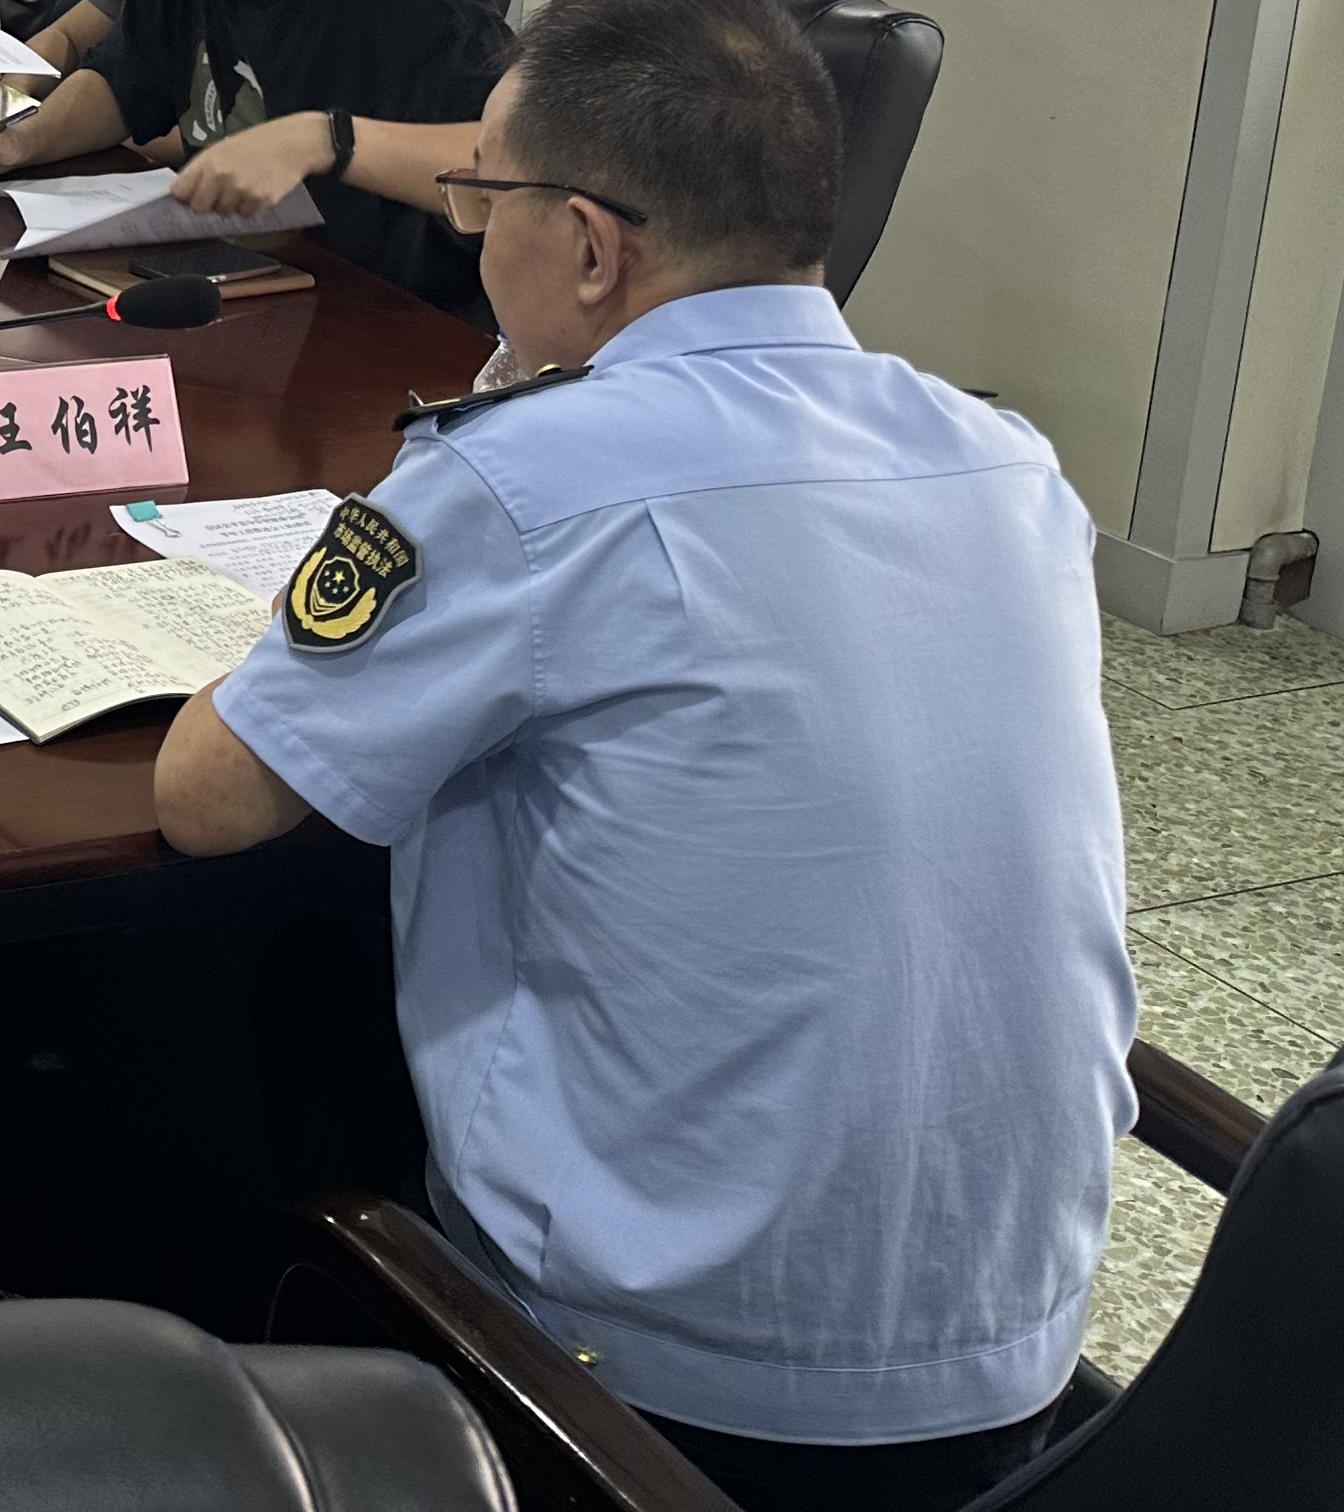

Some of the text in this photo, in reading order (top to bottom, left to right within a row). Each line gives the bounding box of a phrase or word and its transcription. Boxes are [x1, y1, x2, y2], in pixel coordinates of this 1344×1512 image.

[333, 523, 393, 579] 市场监管执法
[339, 505, 409, 568] 中华人民共和国
